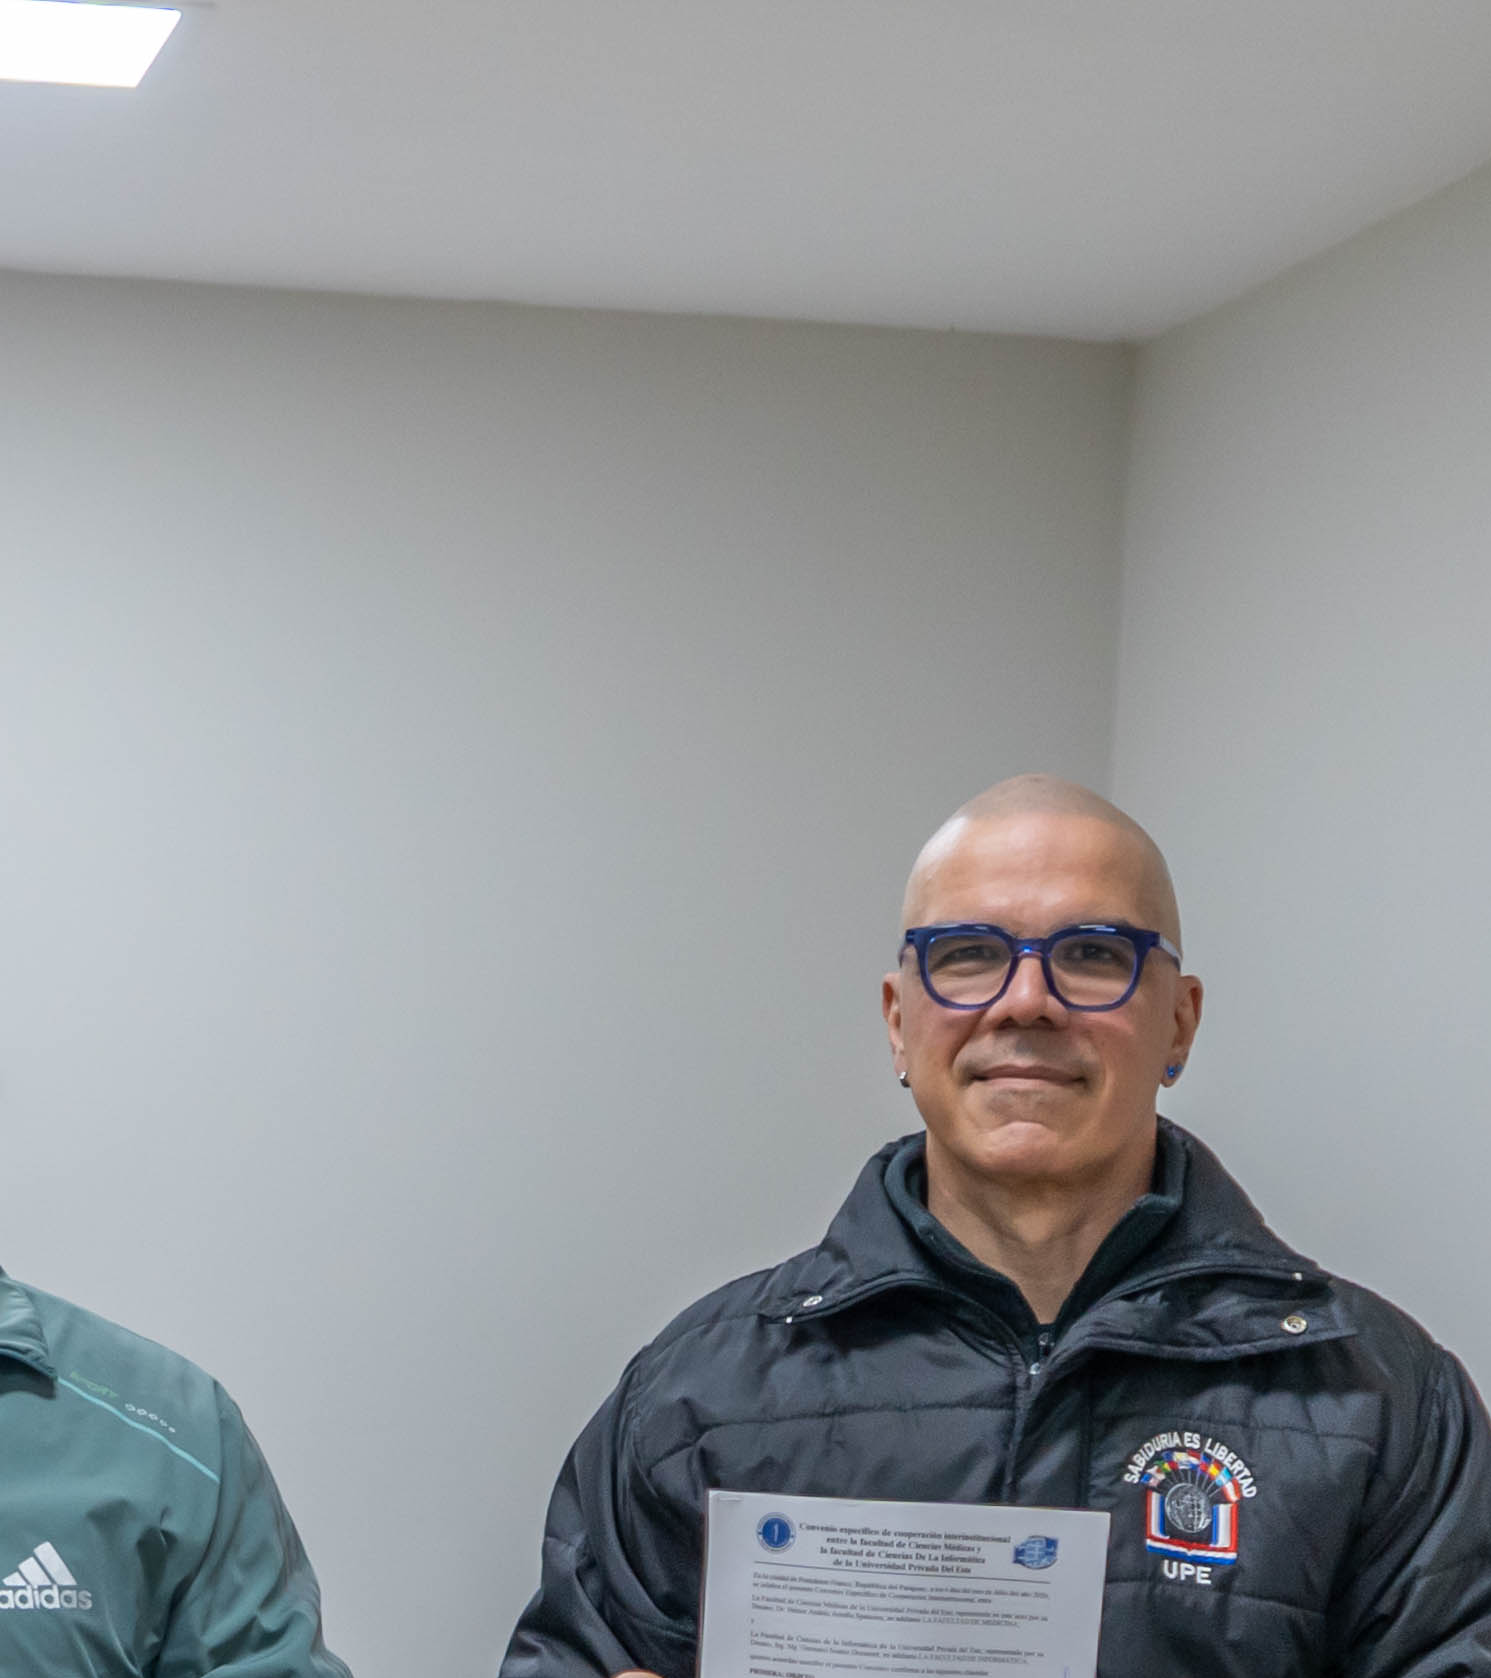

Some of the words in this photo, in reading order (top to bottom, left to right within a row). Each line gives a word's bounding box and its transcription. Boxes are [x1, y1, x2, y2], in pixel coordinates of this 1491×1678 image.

[1124, 1432, 1182, 1484] SABIDURIA
[1184, 1432, 1201, 1449] ES
[1204, 1438, 1257, 1498] LIBERTAD
[1163, 1560, 1212, 1584] UPE
